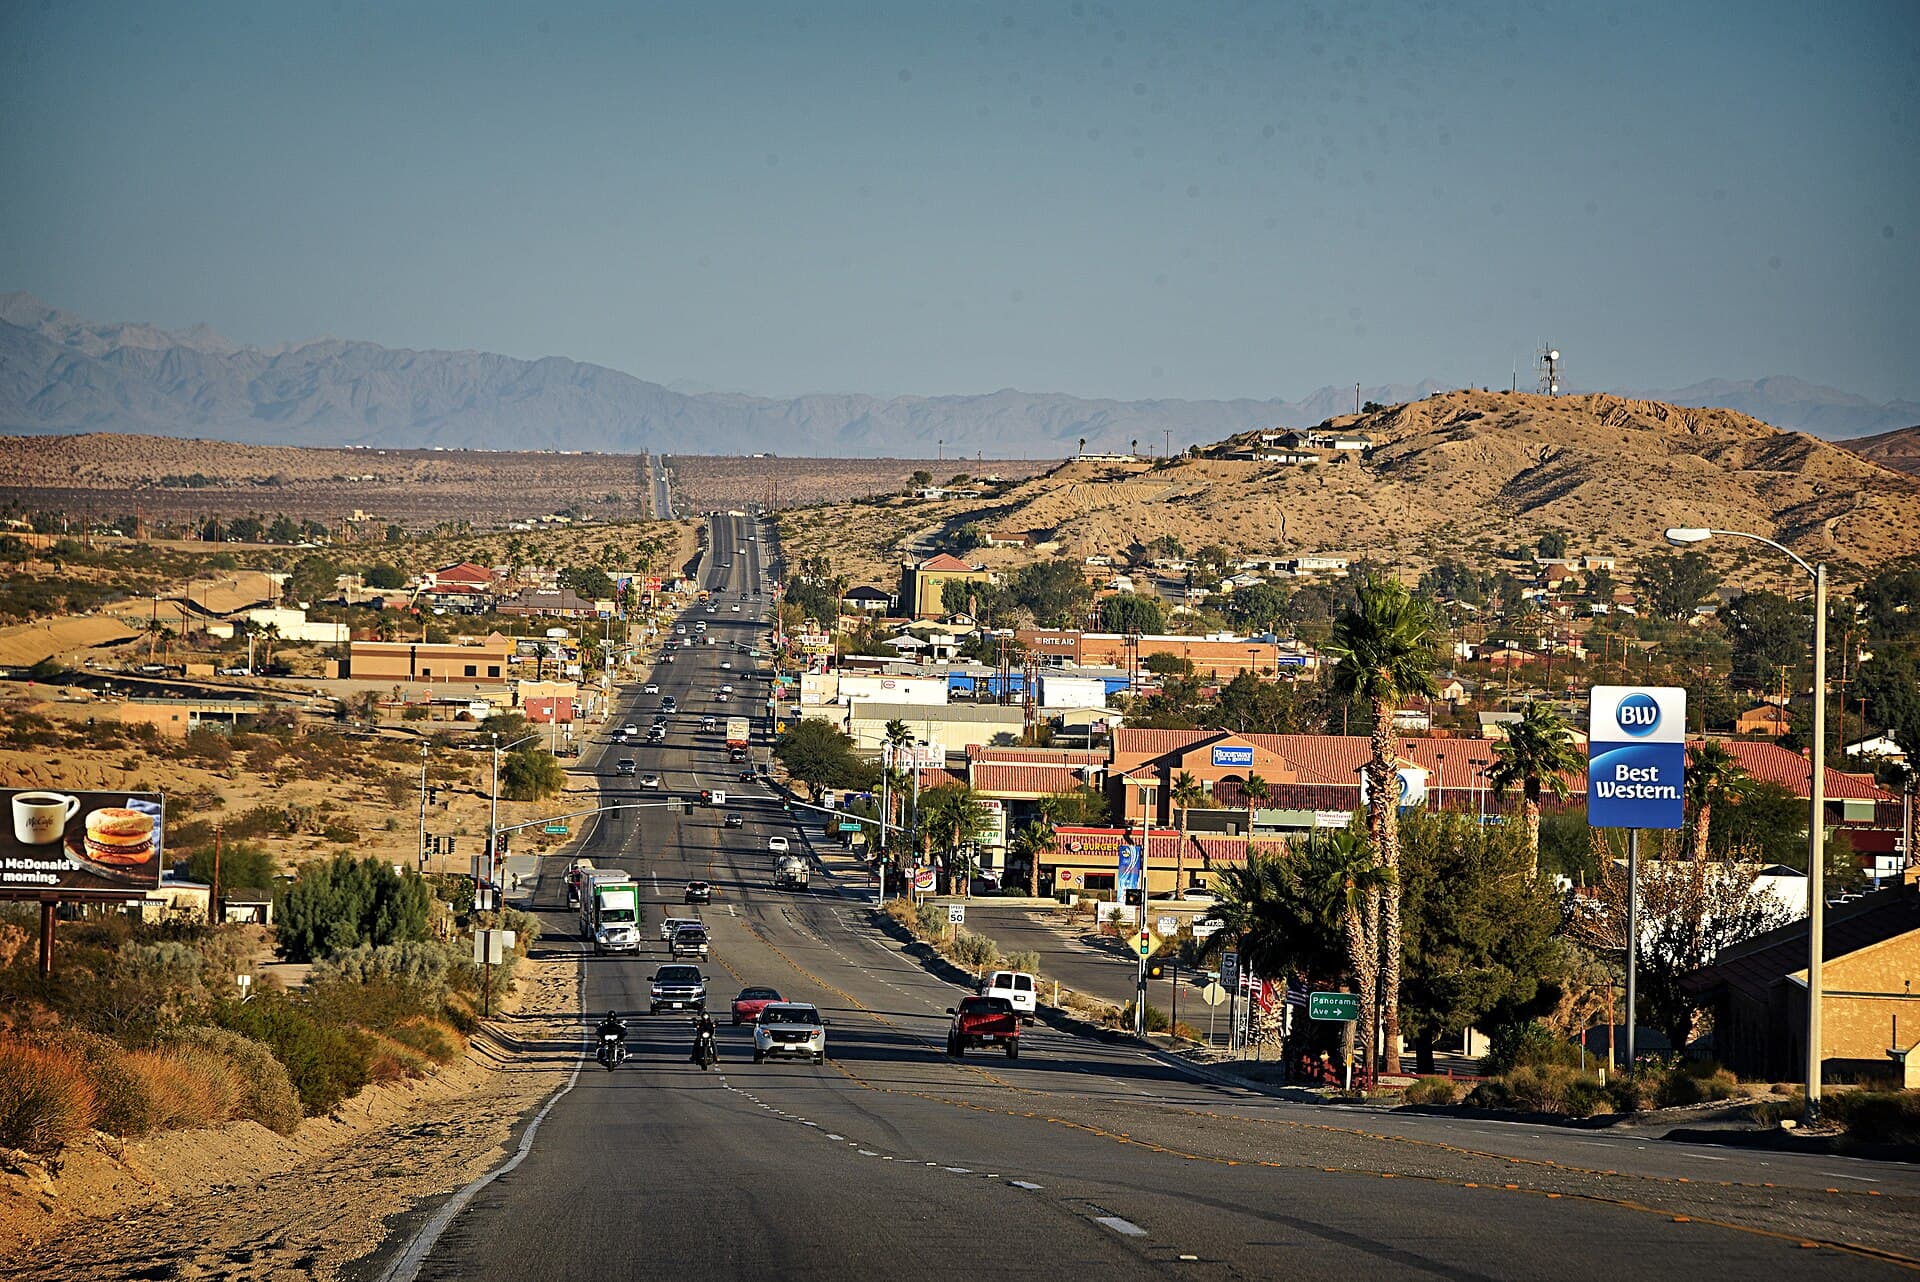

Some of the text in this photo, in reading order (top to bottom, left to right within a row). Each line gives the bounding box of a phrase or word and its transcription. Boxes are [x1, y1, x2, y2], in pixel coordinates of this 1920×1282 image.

[1042, 637, 1075, 646] RITE AID
[1621, 706, 1657, 725] BW
[1616, 764, 1659, 782] Best
[1083, 842, 1118, 851] BURGER
[5, 858, 80, 871] McDonald's
[3, 871, 61, 885] morning.
[915, 873, 933, 884] KING
[950, 914, 963, 922] 50
[1312, 996, 1356, 1005] Panorama
[1312, 1007, 1329, 1015] Ave
